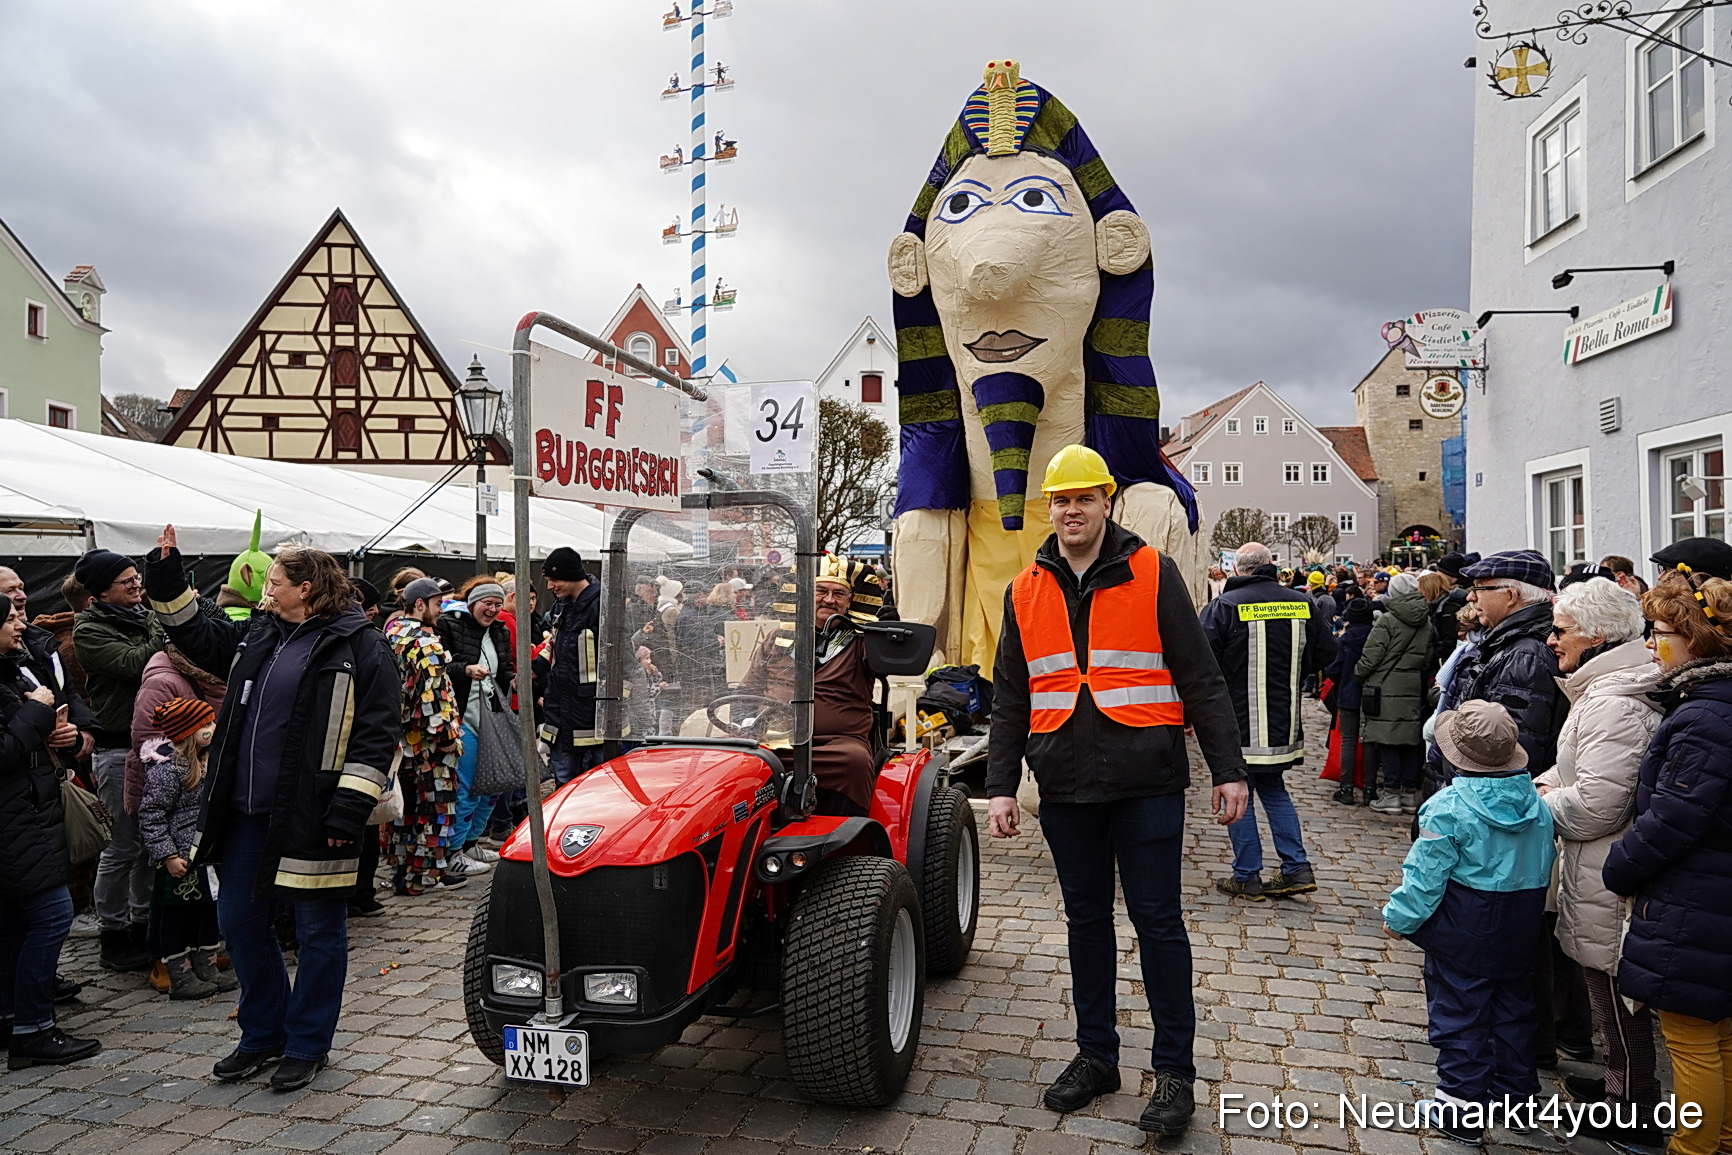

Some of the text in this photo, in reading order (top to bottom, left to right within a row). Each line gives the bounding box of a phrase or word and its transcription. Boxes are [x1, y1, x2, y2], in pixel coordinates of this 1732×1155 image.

[1422, 310, 1461, 320] Pizzeria
[1583, 316, 1604, 330] Pizzeria
[1431, 323, 1452, 332] Café
[1580, 317, 1650, 354] Bella Roma
[1421, 334, 1461, 344] Eisdiele
[585, 379, 623, 439] FF
[756, 397, 804, 442] 34
[535, 428, 679, 497] BURGGRIESBACH
[1253, 603, 1307, 612] Burggriesbach
[508, 1041, 514, 1049] D
[523, 1031, 550, 1055] NM
[510, 1055, 583, 1082] XX 128
